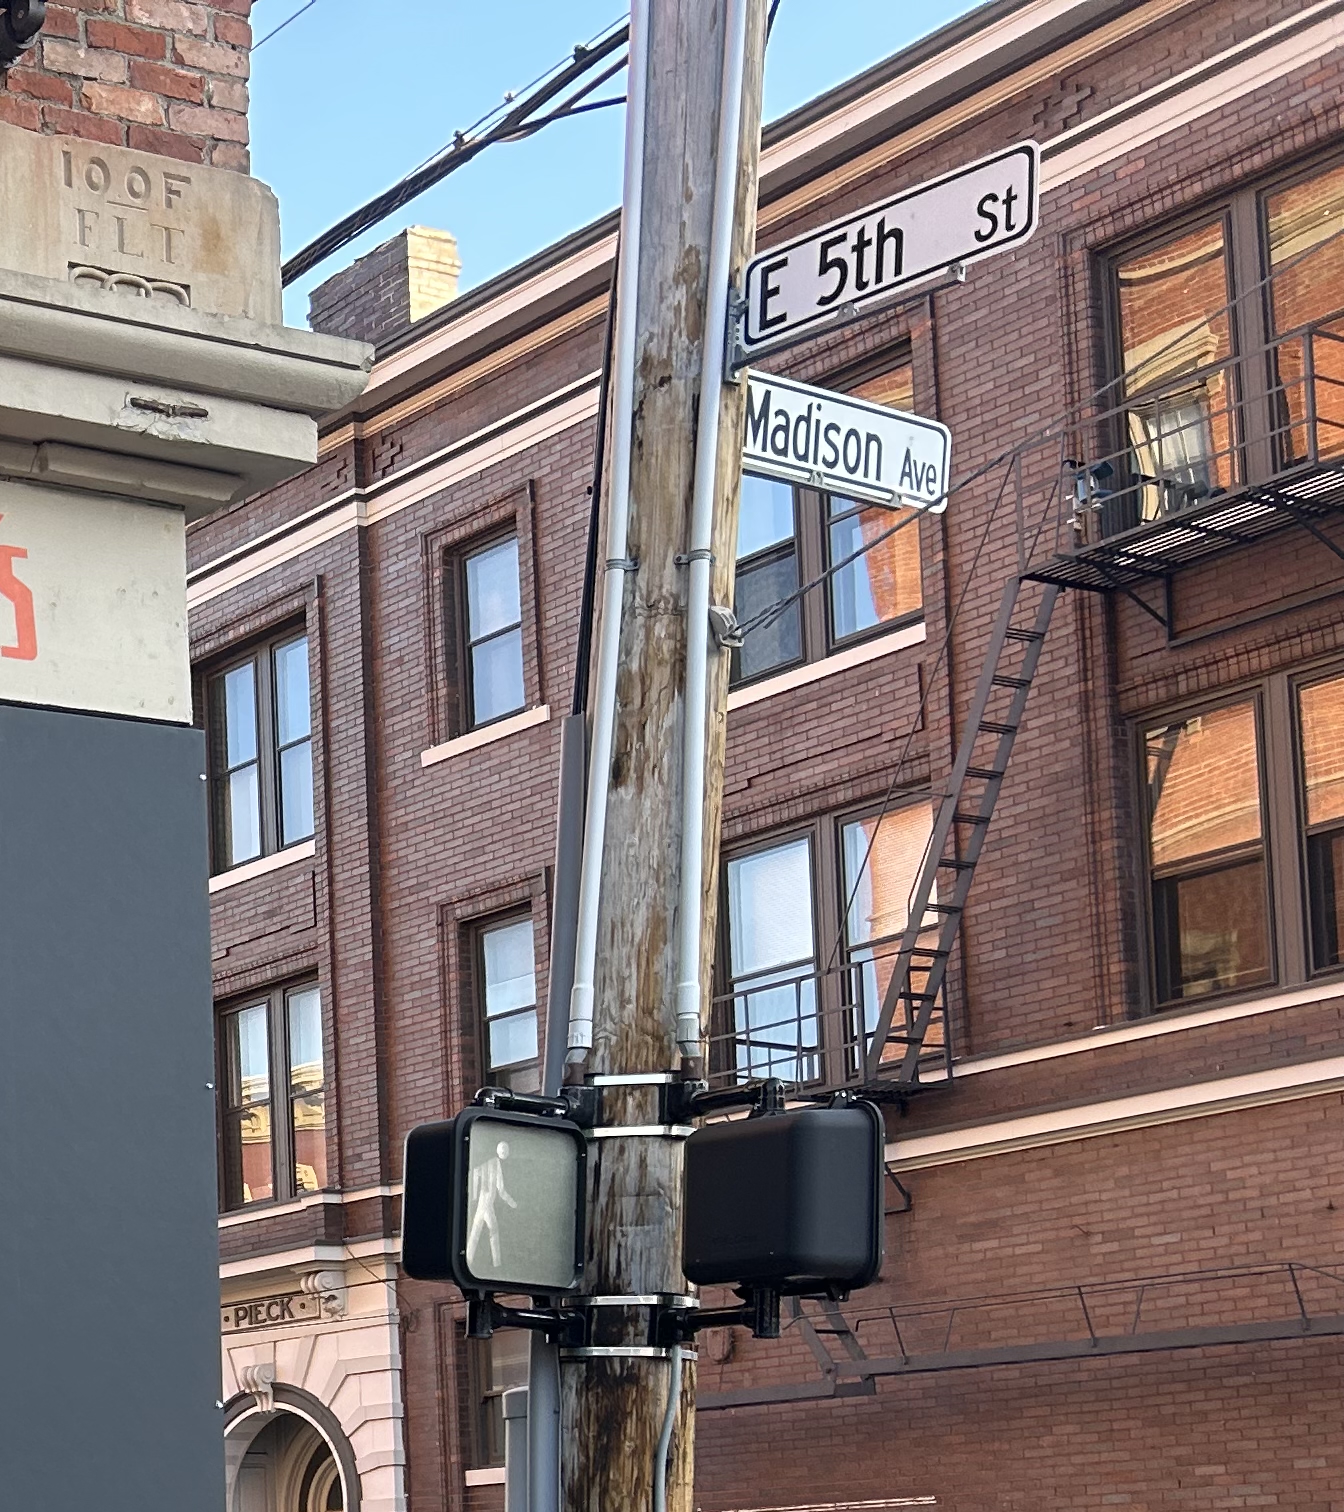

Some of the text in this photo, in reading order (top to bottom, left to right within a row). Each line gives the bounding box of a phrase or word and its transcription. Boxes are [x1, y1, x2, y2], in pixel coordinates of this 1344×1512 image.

[759, 184, 1018, 331] E 5th St
[744, 386, 937, 494] Madison Ave
[234, 1296, 294, 1328] PIECK
